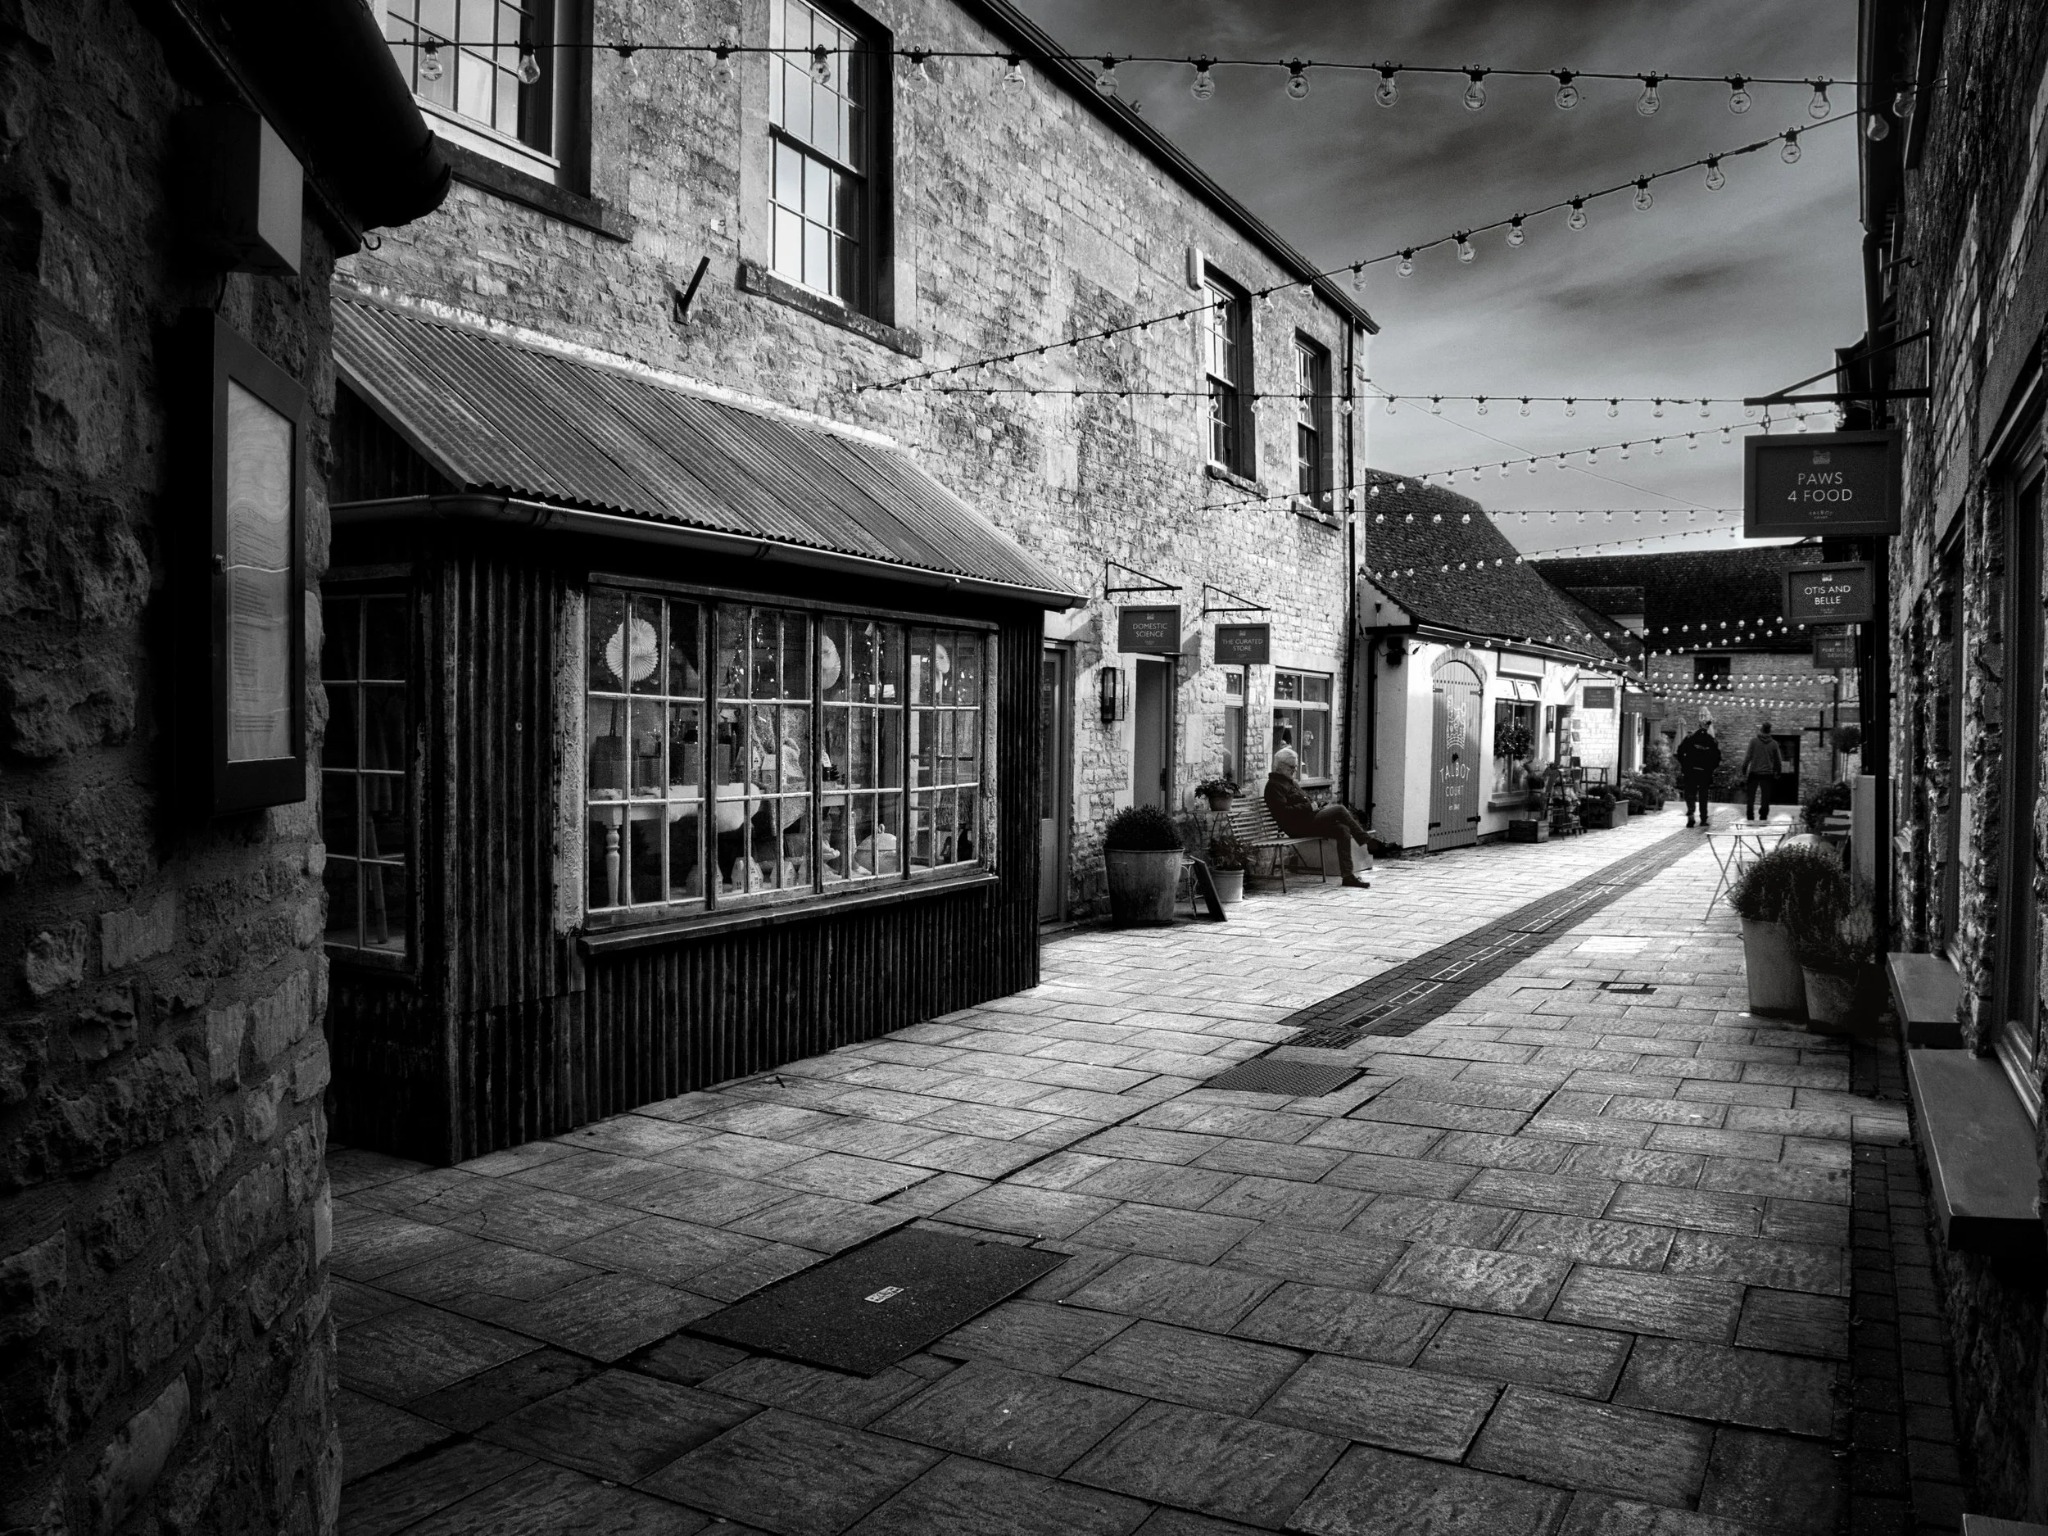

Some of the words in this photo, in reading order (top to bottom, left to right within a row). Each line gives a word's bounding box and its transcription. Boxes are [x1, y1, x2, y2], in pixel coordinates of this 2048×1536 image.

[1798, 471, 1843, 485] PAWS
[1787, 490, 1797, 502] 4
[1803, 488, 1853, 502] FOOD
[1804, 586, 1826, 595] OTIS
[1828, 585, 1851, 593] AND
[1814, 595, 1841, 605] BELLE
[1132, 622, 1168, 630] DOMESTIC
[1135, 630, 1164, 638] SCIENCE
[1440, 761, 1470, 783] TALBOT
